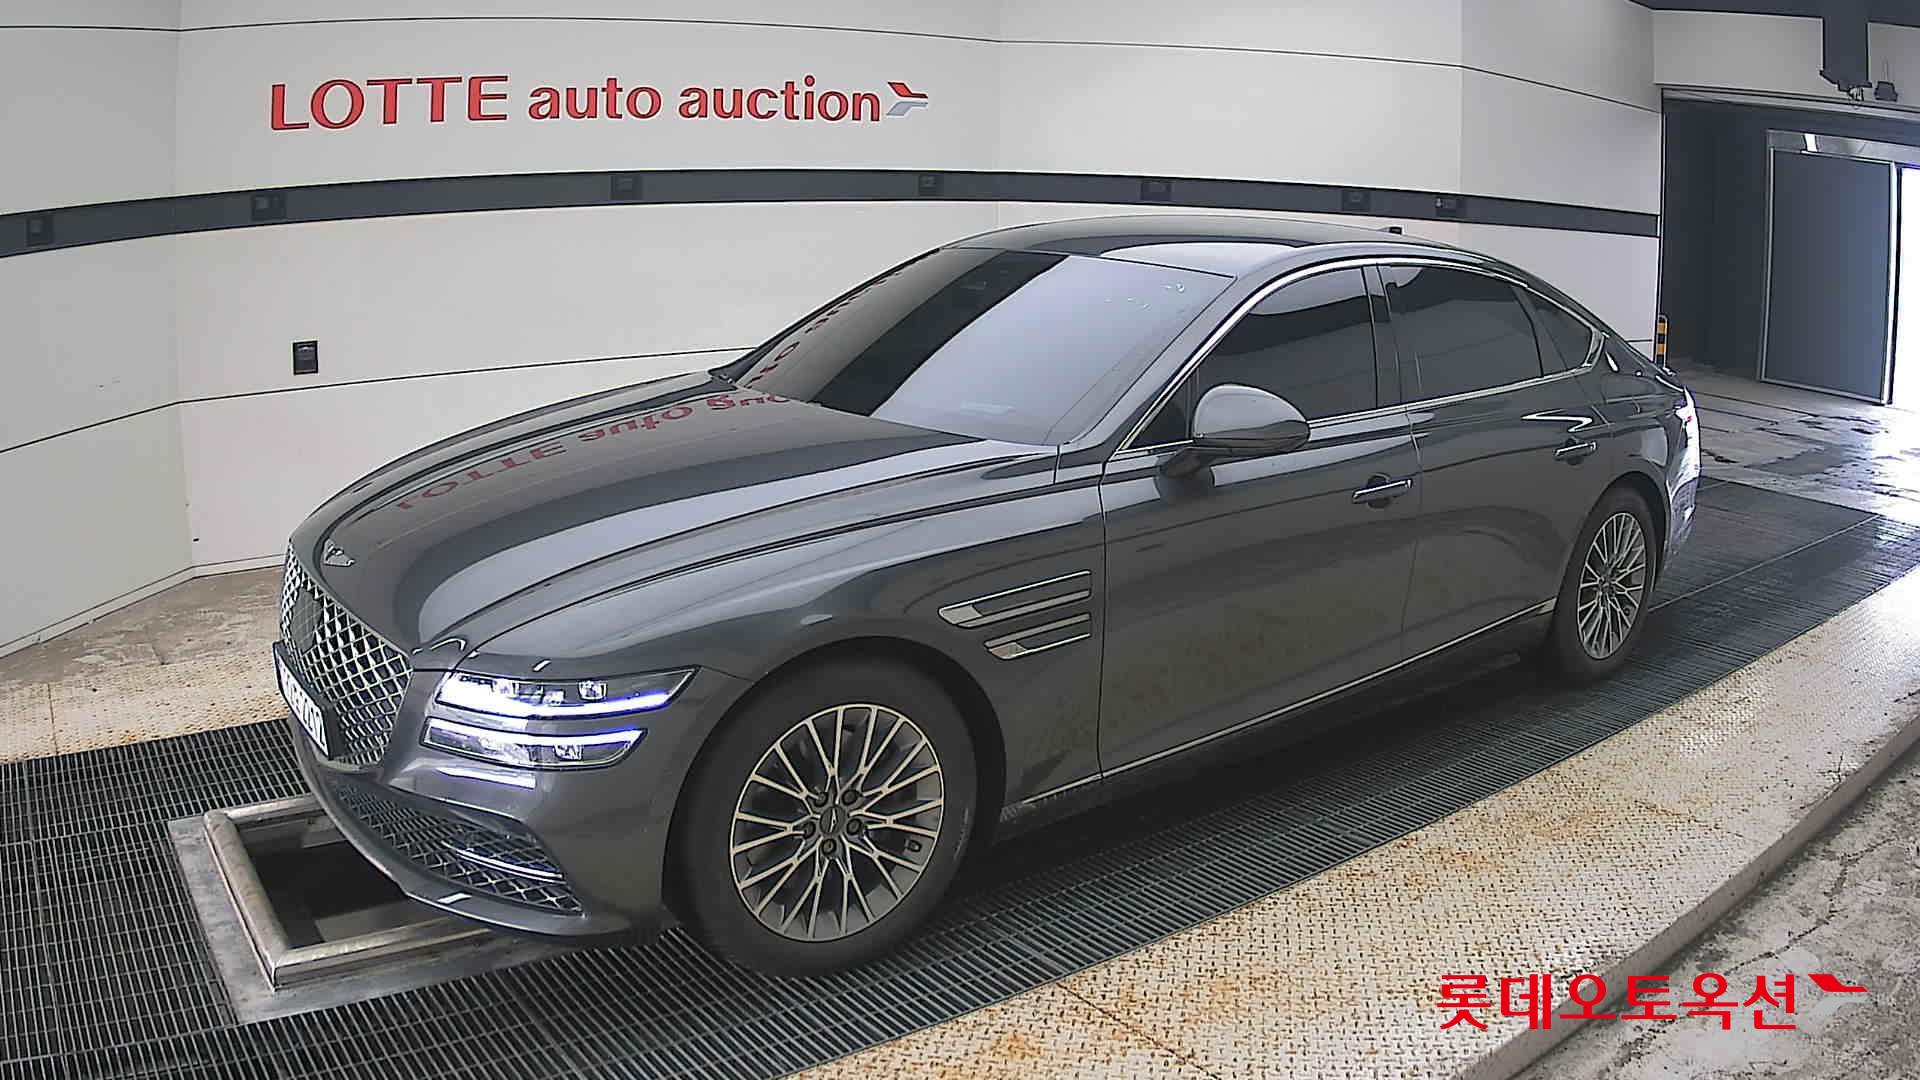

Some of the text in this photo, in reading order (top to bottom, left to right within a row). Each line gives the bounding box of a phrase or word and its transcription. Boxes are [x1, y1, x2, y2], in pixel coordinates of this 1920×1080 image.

[271, 75, 881, 131] LOTTE auto auction
